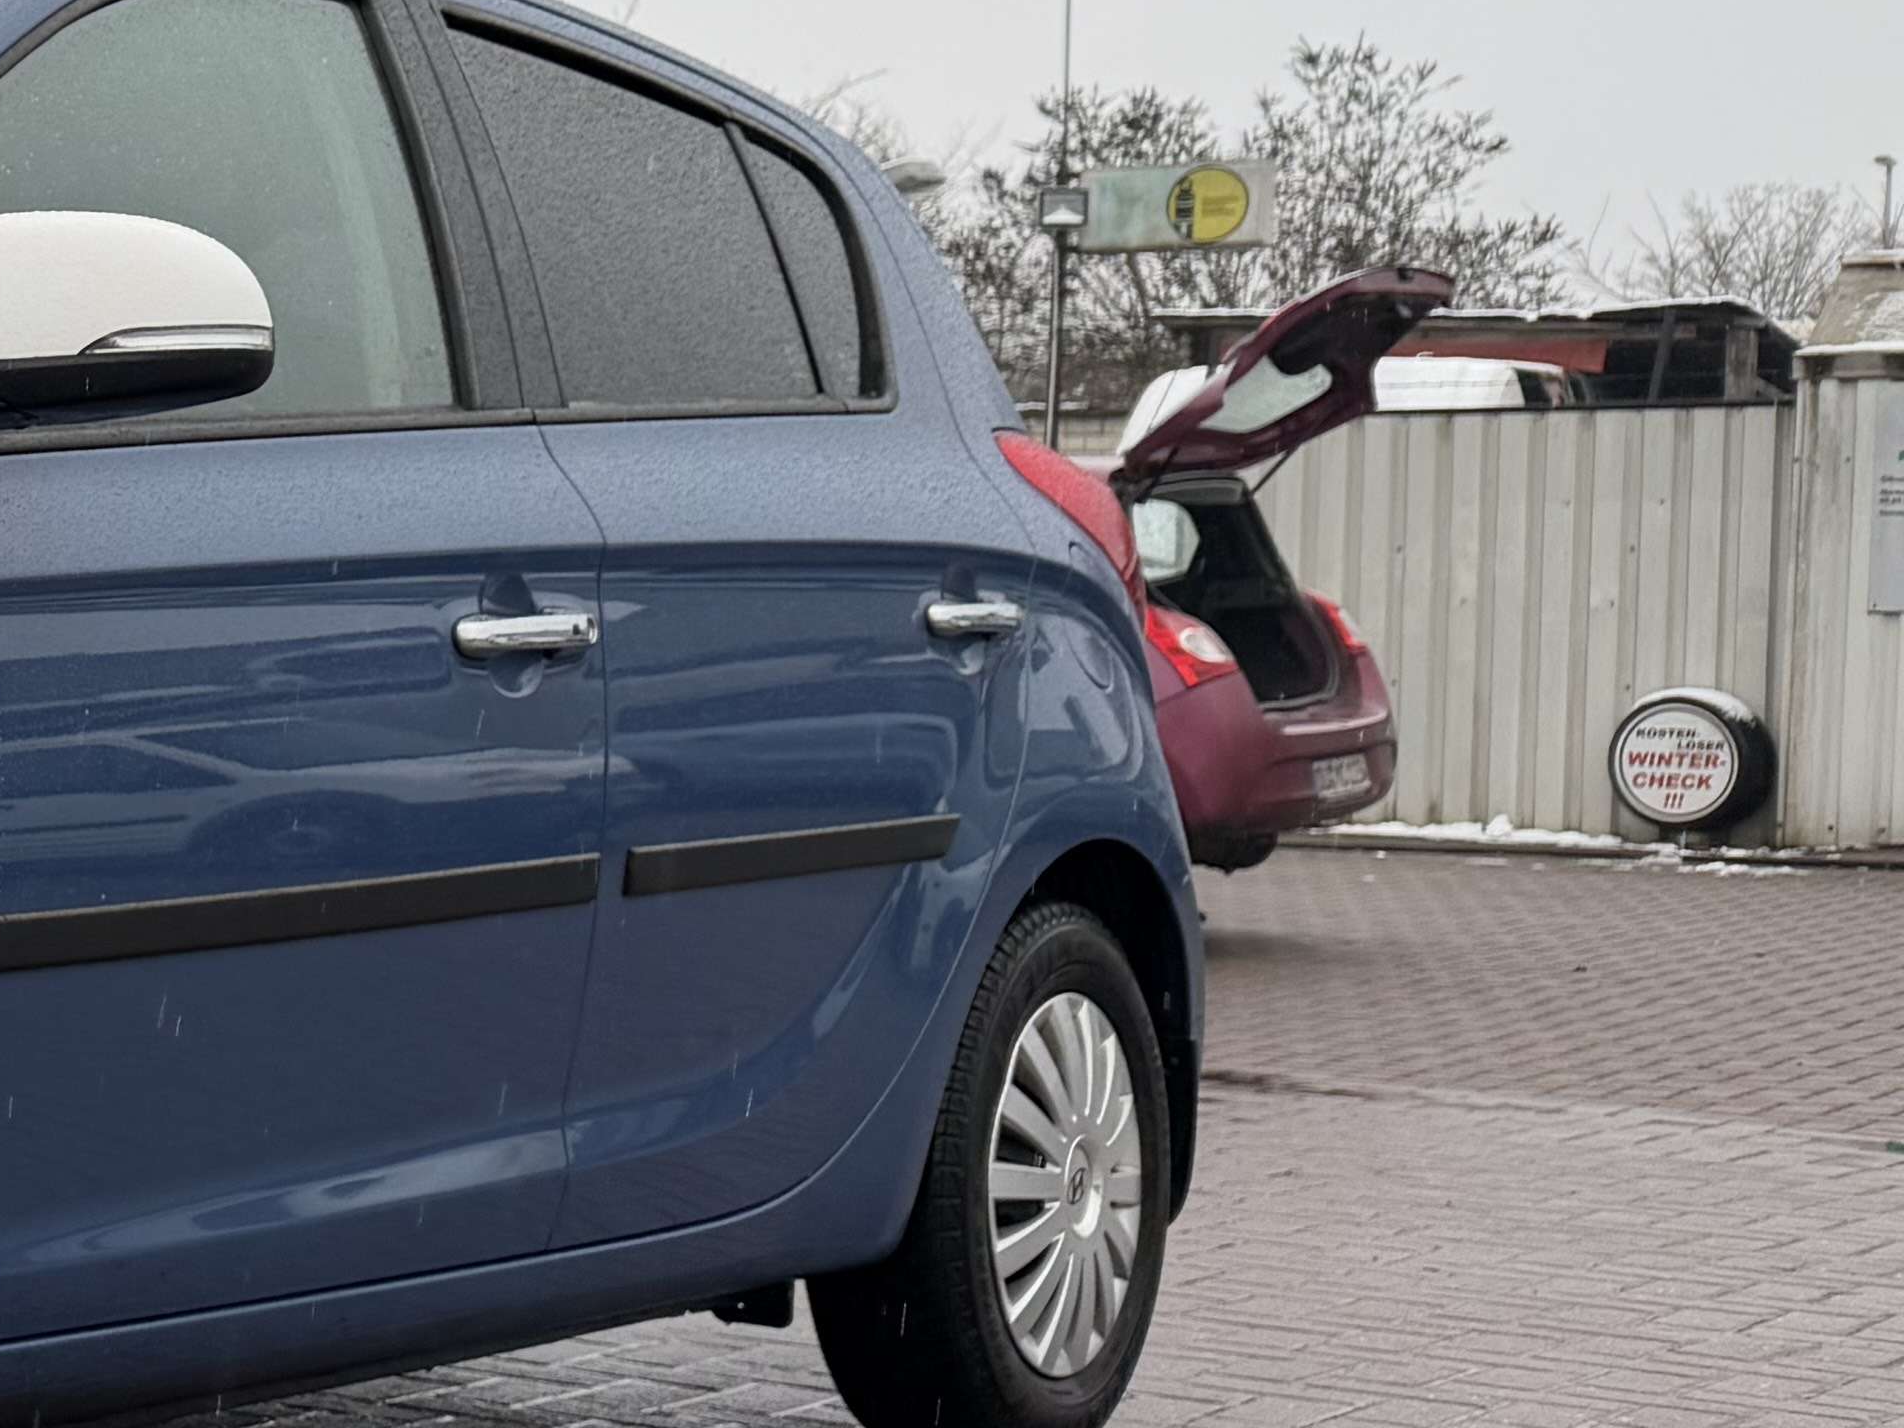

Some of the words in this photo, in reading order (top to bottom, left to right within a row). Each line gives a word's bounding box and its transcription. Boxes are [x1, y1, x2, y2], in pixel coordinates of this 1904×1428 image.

[1677, 739, 1726, 752] LOSER
[1627, 750, 1729, 770] WINTER-
[1632, 771, 1713, 791] CHECK
